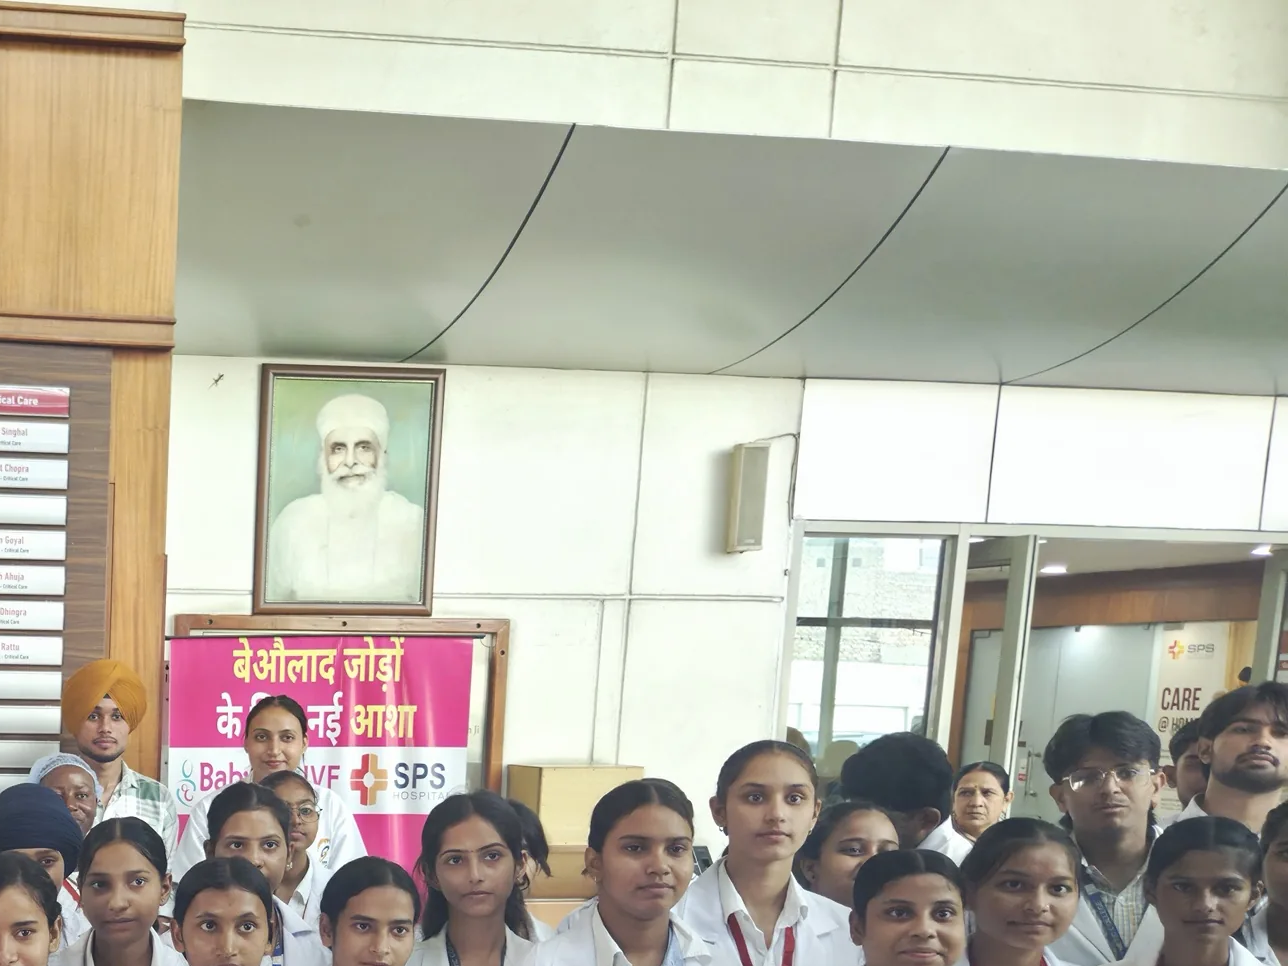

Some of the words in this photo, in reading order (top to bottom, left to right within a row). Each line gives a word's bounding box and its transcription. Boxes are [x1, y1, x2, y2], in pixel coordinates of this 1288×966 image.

[17, 396, 39, 406] Care
[1, 427, 28, 437] Singhal
[5, 464, 29, 474] Chopra
[5, 536, 24, 545] Goyal
[4, 573, 24, 582] Ahuja
[0, 608, 27, 617] Dhingra
[1187, 643, 1215, 654] SPS
[232, 636, 338, 684] बेऔलाद
[343, 636, 405, 692] जोड़ों
[1161, 687, 1202, 711] CARE
[216, 692, 244, 739] के
[307, 692, 344, 746] नई
[350, 704, 418, 738] आशा
[1158, 716, 1169, 732] @
[394, 762, 446, 790] SPS
[393, 791, 449, 800] HOSPITA
